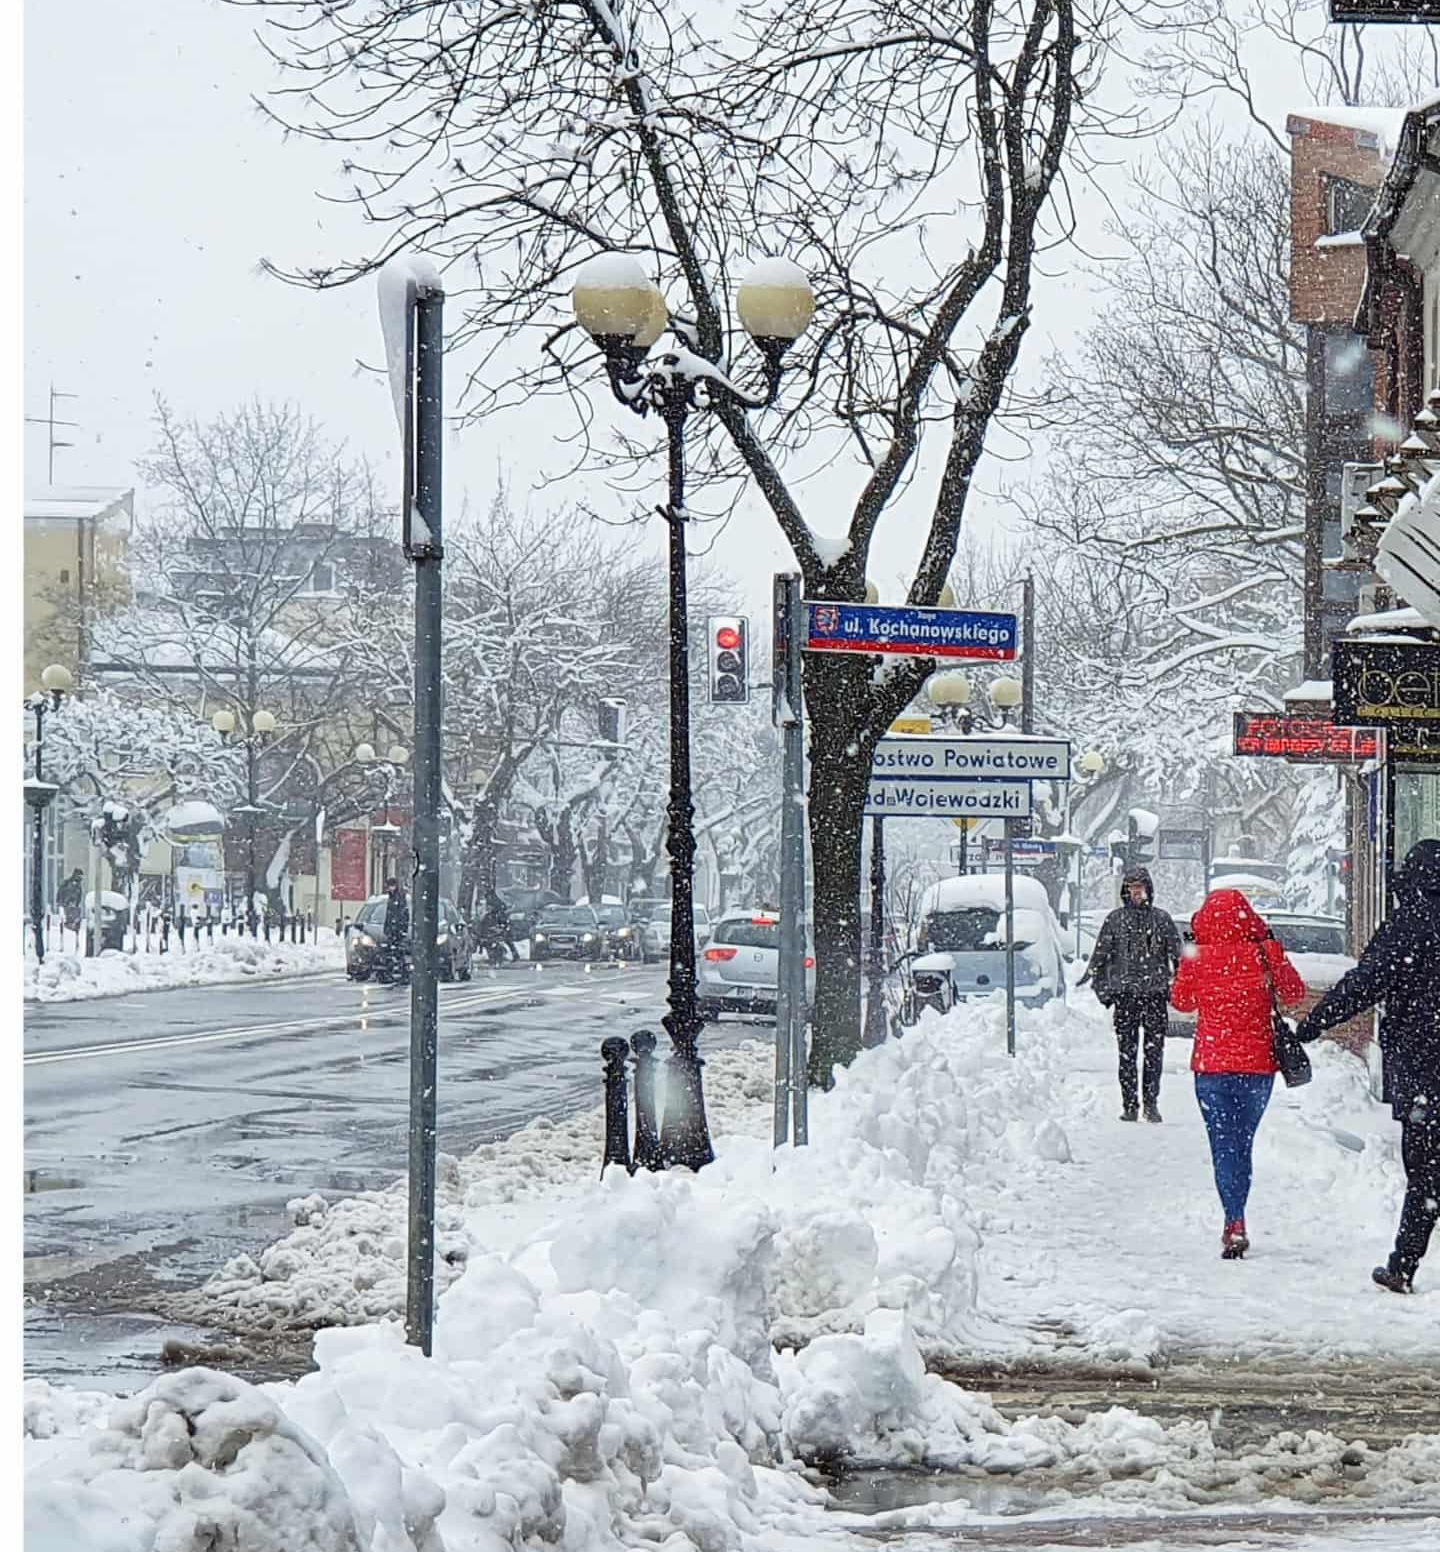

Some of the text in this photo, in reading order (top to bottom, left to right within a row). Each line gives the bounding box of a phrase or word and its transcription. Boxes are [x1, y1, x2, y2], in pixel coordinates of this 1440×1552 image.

[844, 618, 1009, 644] ul. Kochanowskiego
[873, 749, 1058, 769] ostwo Powiatowe
